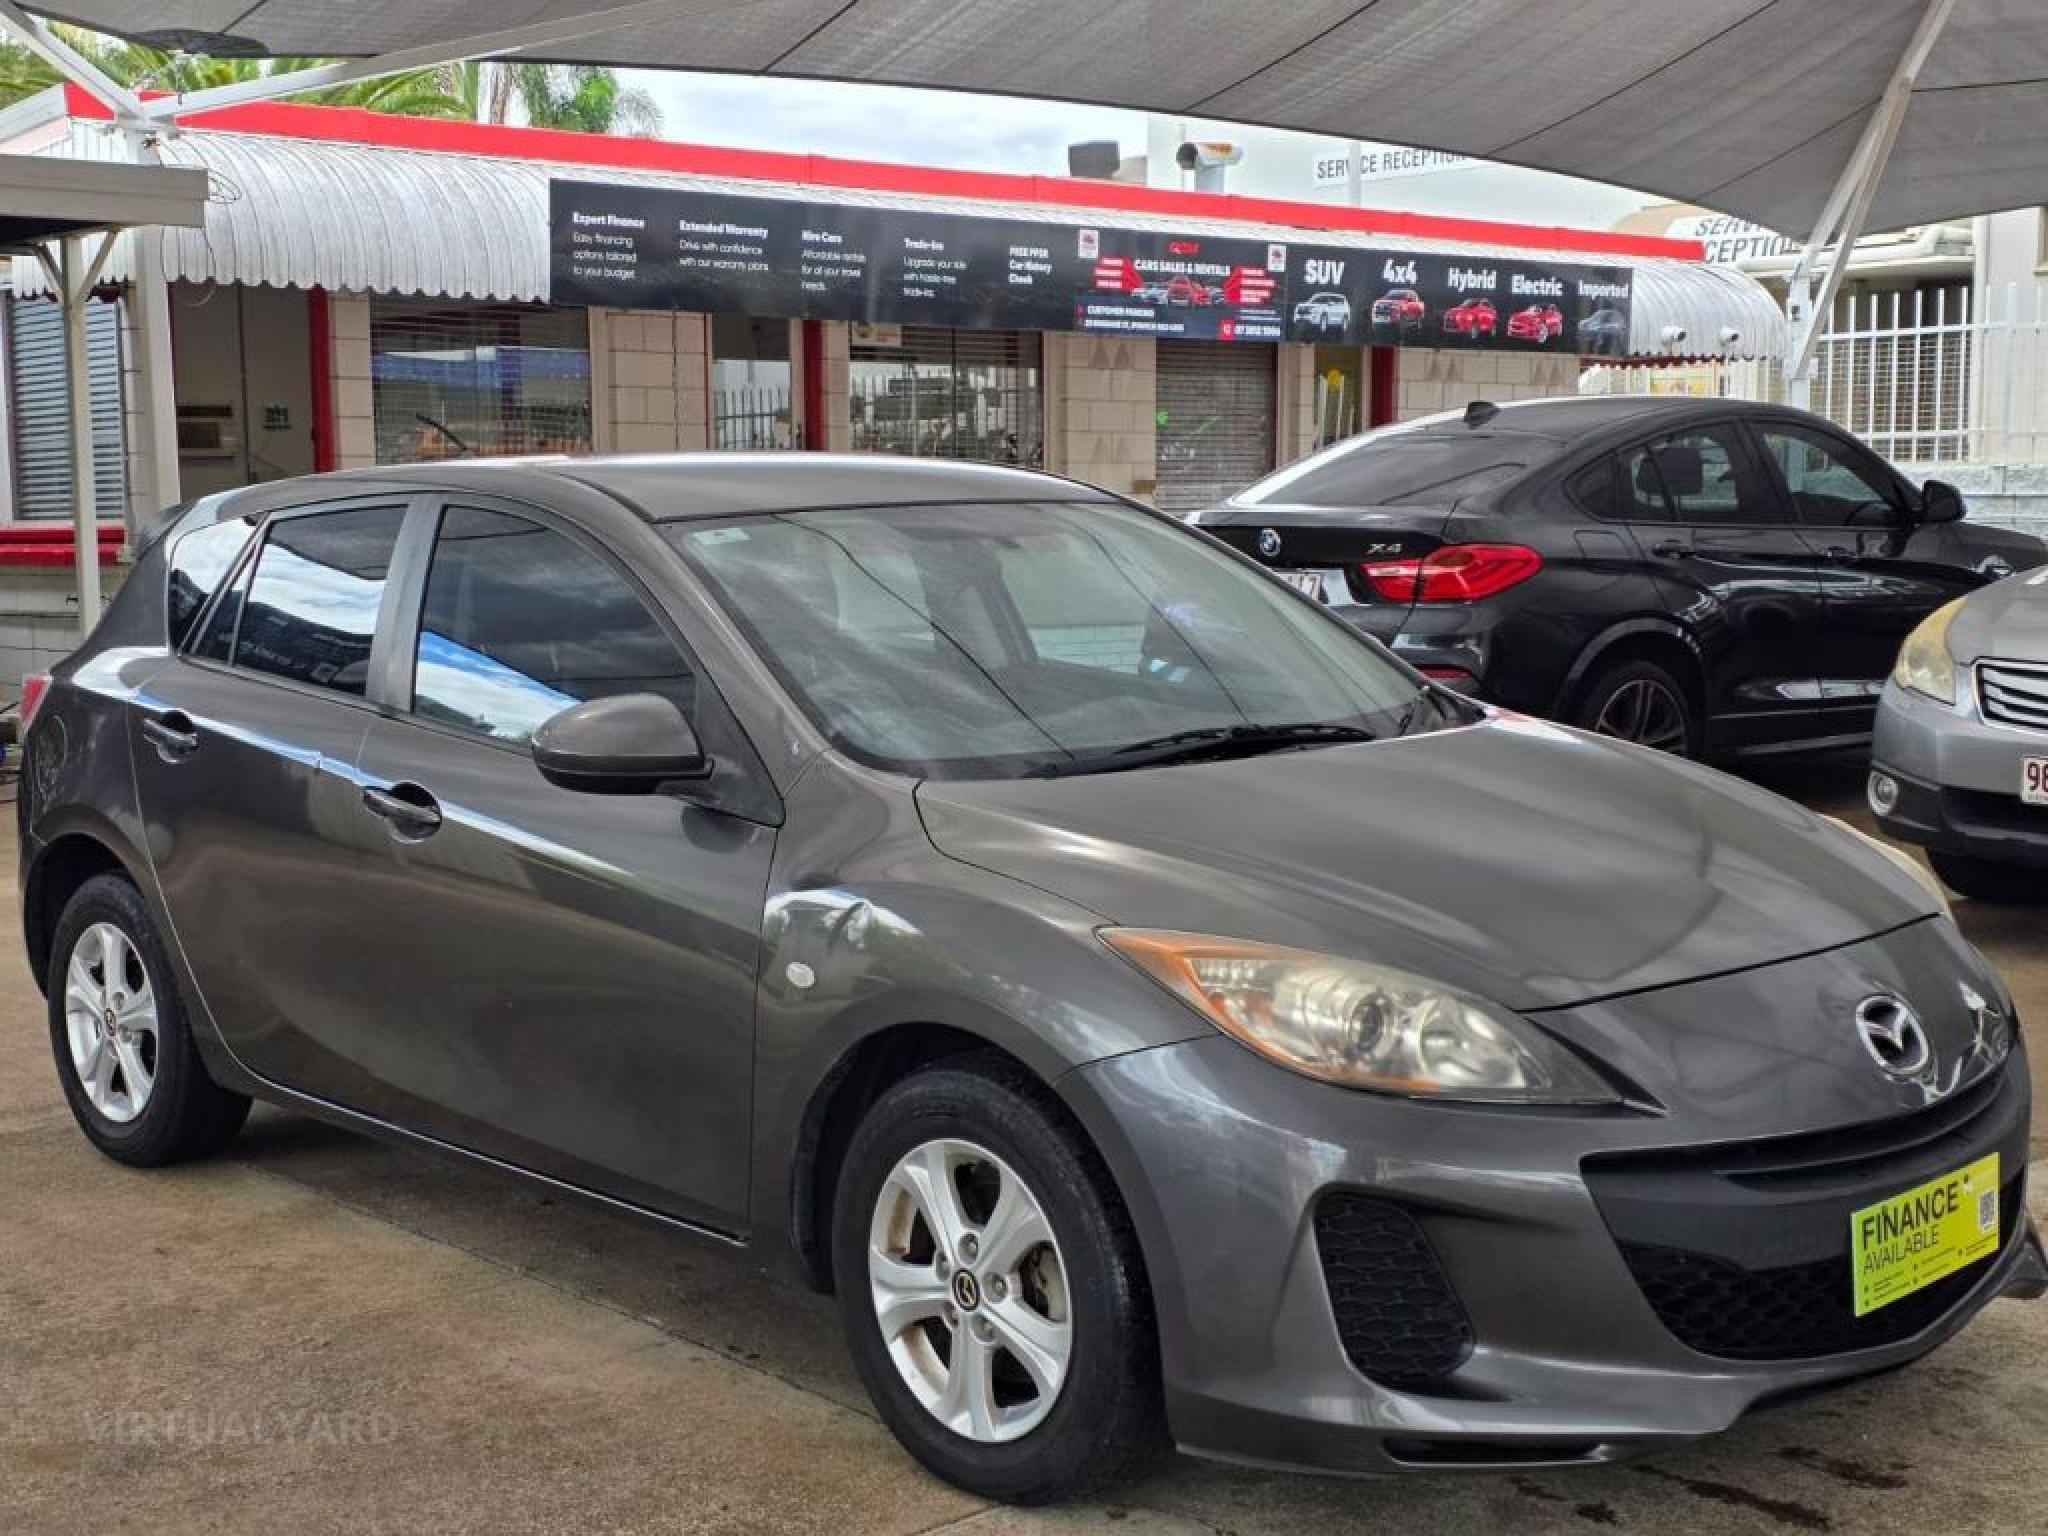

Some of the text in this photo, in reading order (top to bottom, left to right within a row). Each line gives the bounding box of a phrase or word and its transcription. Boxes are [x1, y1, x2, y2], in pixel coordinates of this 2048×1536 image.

[1317, 153, 1377, 179] SERVCE
[573, 211, 645, 228] Expert Finance
[680, 219, 768, 239] Extended Warranty
[573, 232, 633, 249] Easy financing
[680, 239, 763, 255] Drive with confidence
[822, 232, 843, 245] Cars
[573, 250, 637, 263] options tailored
[1010, 246, 1029, 257] FREE
[573, 265, 583, 276] to
[584, 267, 603, 281] your
[680, 257, 697, 269] with
[699, 260, 711, 269] our
[713, 260, 746, 273] warranty
[802, 265, 812, 275] for
[824, 268, 839, 279] your
[904, 257, 936, 270] Upgrade
[937, 261, 952, 272] your
[1134, 258, 1158, 271] CARS
[1303, 258, 1345, 286] SUV
[1382, 258, 1418, 285] 4x4
[1448, 267, 1497, 293] Hybrid
[1511, 273, 1564, 297] Electric
[1578, 279, 1629, 300] Imported
[1367, 543, 1403, 555] X4
[1861, 1181, 1960, 1251] FINANCE
[1863, 1224, 1940, 1276] AVAILABLE
